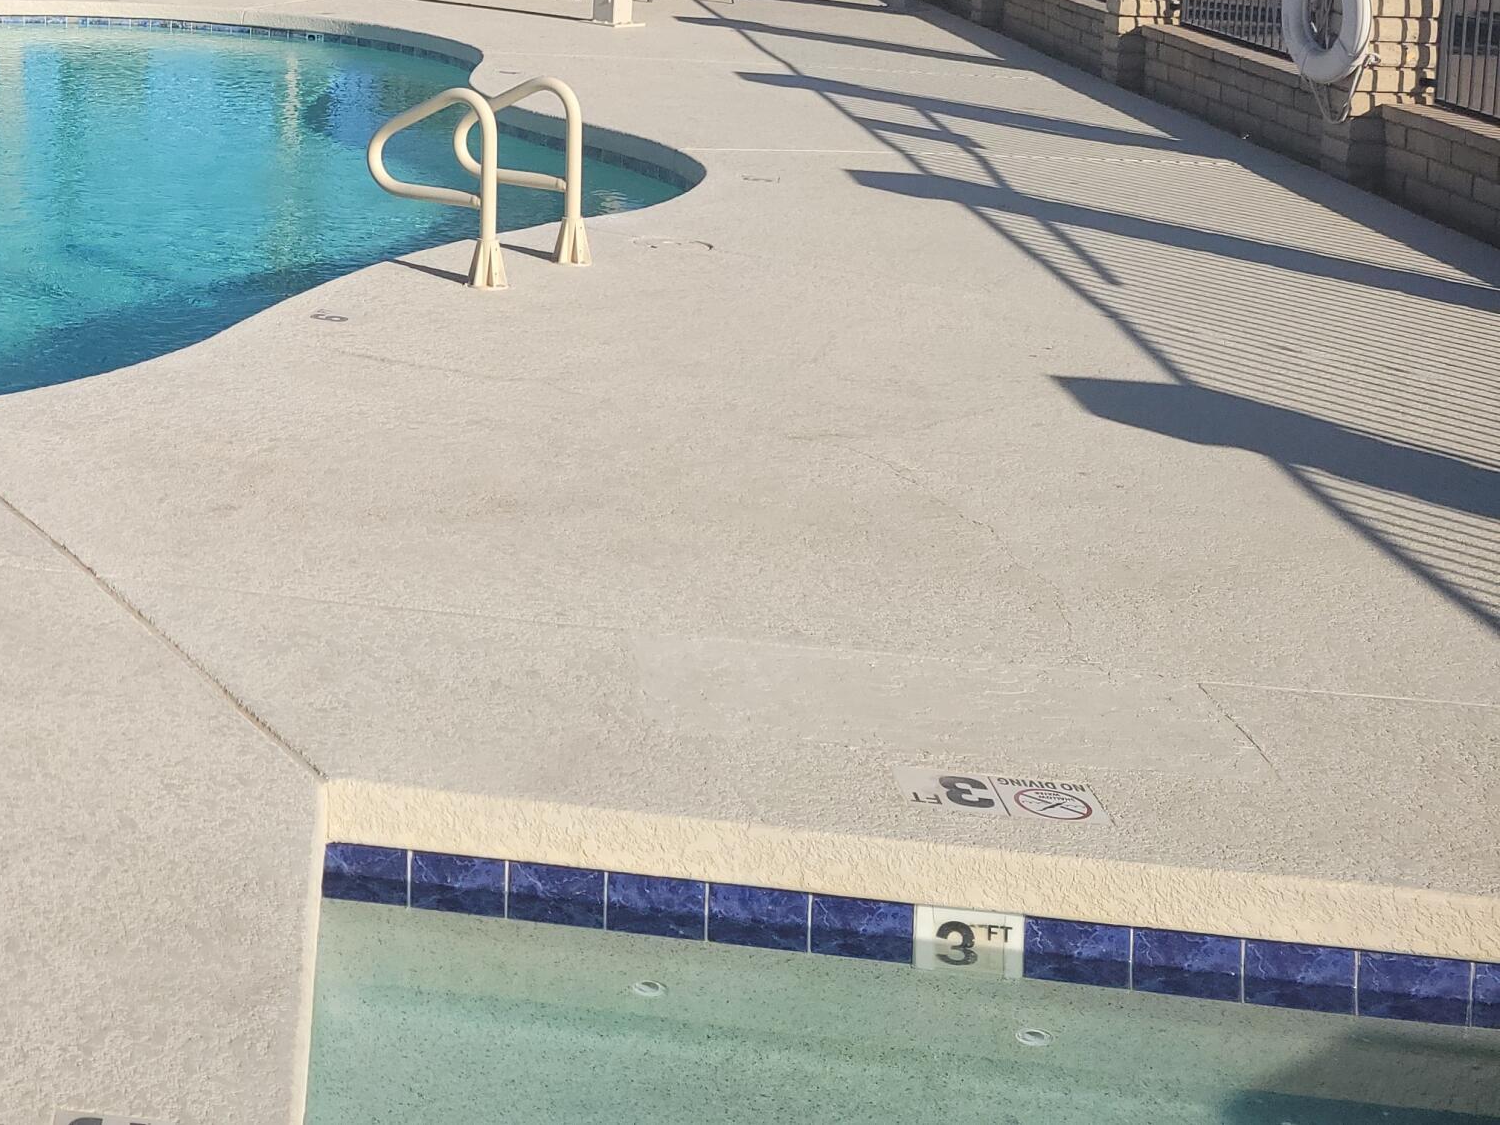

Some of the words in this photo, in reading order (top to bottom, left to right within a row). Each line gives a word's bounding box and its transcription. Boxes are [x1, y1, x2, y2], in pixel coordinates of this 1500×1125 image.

[996, 777, 1057, 790] DIVING
[1060, 783, 1086, 793] NO
[911, 792, 943, 805] FT
[938, 776, 995, 809] 3
[936, 921, 978, 966] 3
[987, 925, 1013, 943] FT
